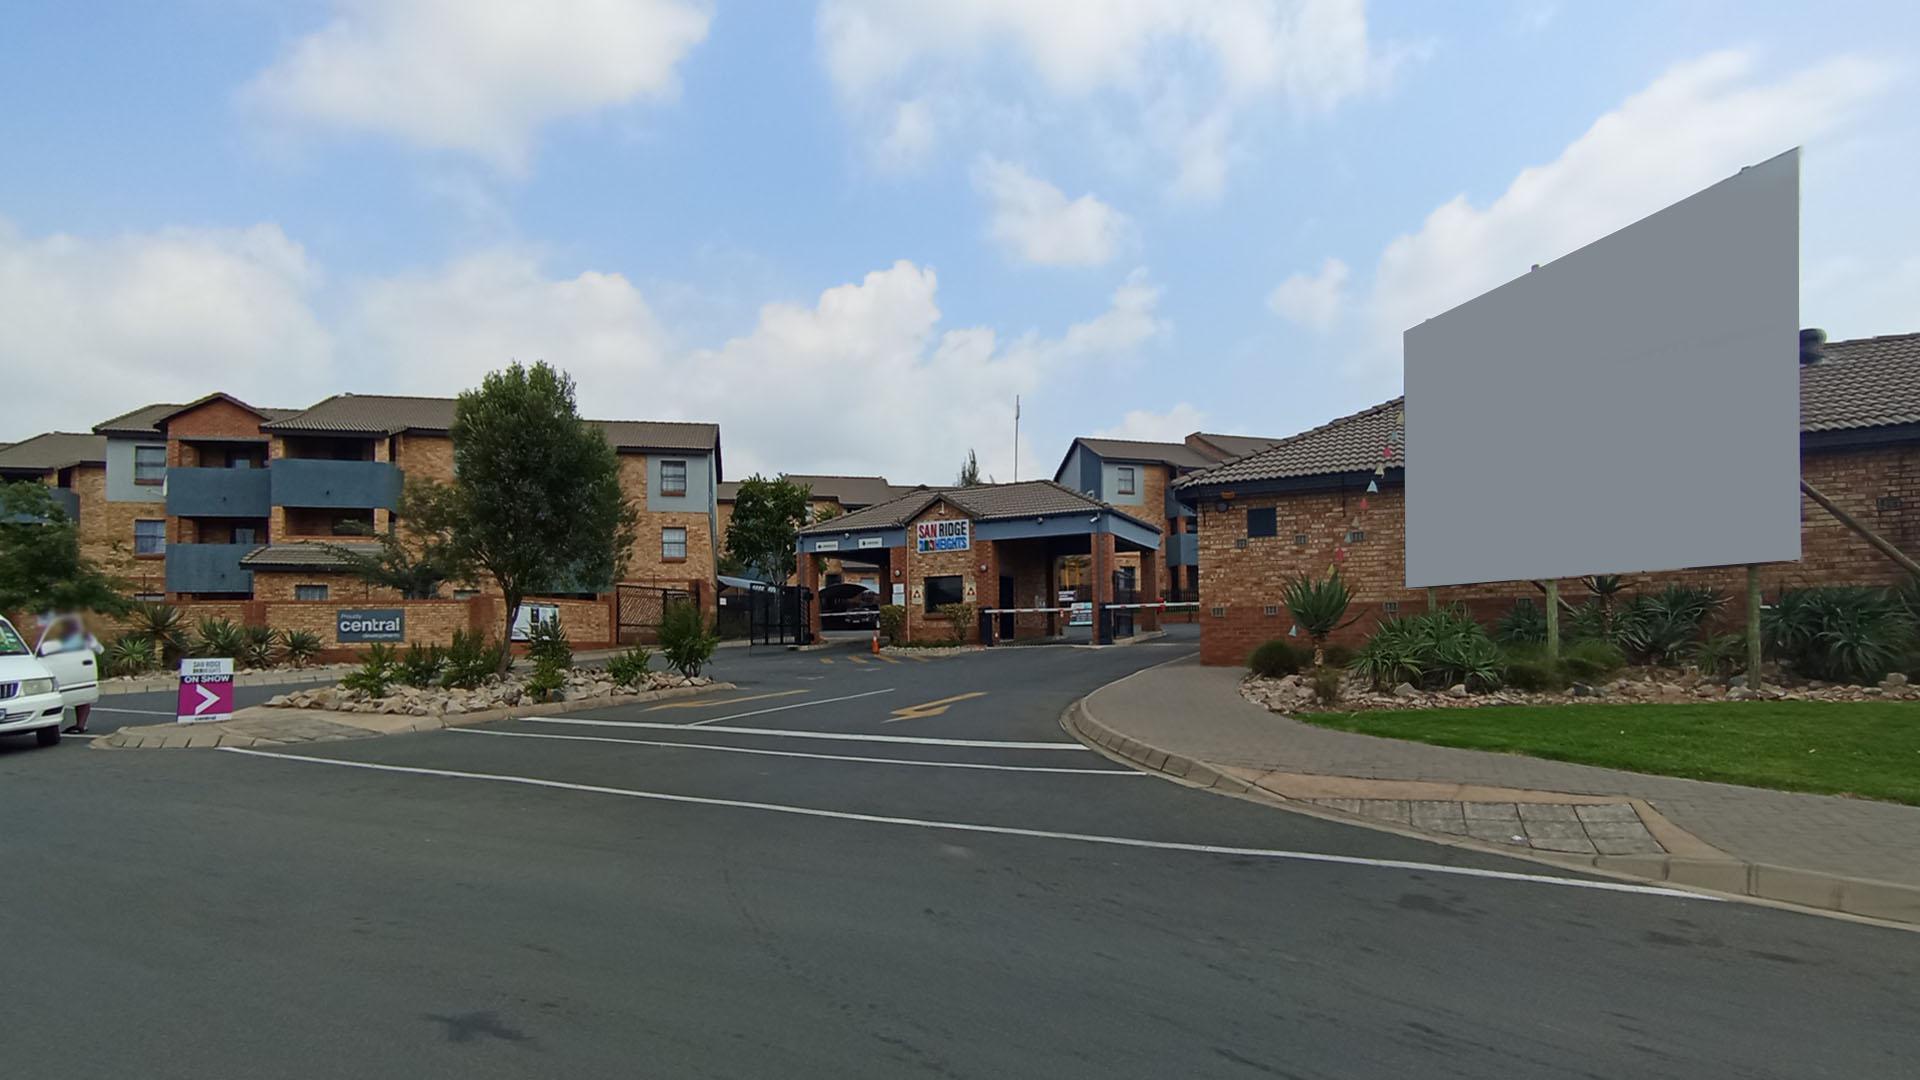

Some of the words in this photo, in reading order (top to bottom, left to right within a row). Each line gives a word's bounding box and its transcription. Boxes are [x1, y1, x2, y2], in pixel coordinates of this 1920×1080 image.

[919, 524, 937, 539] SAN
[939, 521, 967, 537] RIDGE
[340, 617, 400, 632] central
[184, 675, 199, 683] ON
[201, 674, 229, 683] SHOW
